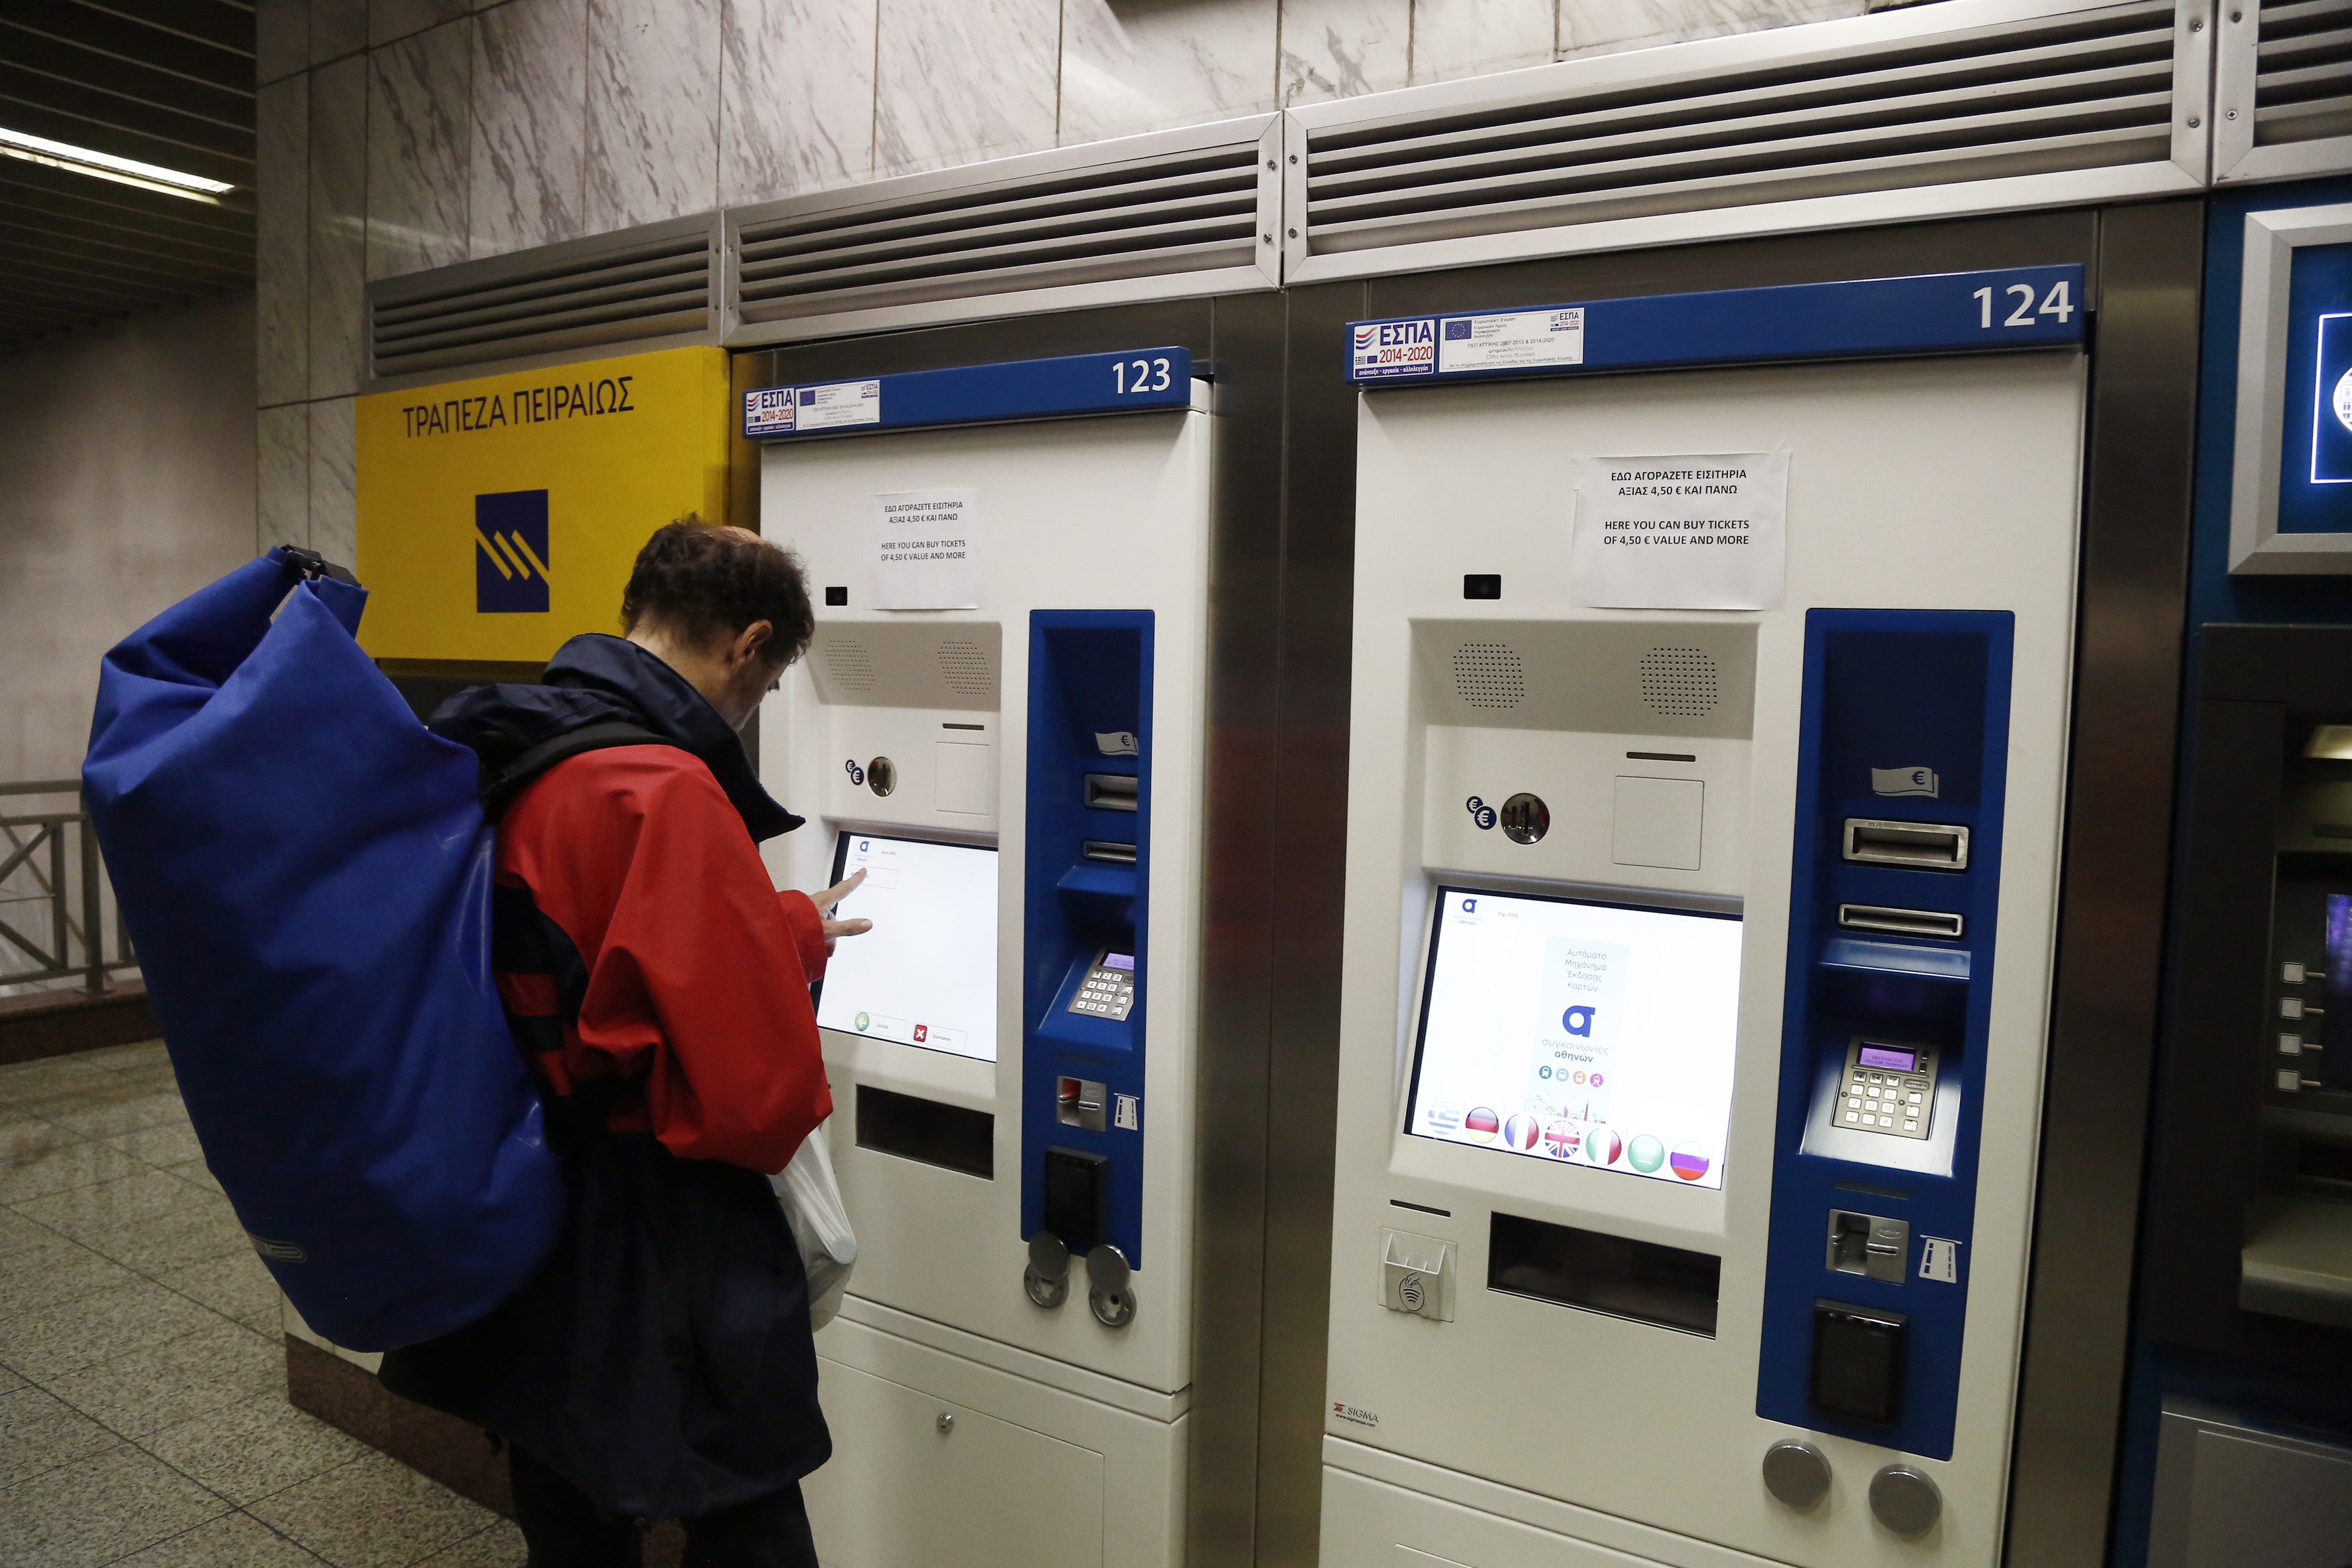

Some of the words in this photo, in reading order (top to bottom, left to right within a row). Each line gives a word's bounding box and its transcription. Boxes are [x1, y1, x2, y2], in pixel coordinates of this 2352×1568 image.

[1974, 281, 2074, 328] 124
[1380, 322, 1433, 346] ΕΣΠΑ
[1379, 346, 1433, 363] 2014-2020
[1113, 358, 1170, 394] 123
[762, 390, 793, 408] ΕΣΠΑ
[402, 394, 507, 438] ΤΡΑΠΕΖΑ
[513, 375, 634, 425] ΠΕΙΡΑΙΩΣ
[762, 408, 793, 422] 2014-2020
[1611, 472, 1632, 481] ΕΔΩ
[1634, 471, 1693, 481] ΑΓΟΡΑΖΕΤΕ
[1696, 470, 1747, 479] ΕΙΣΙΤΗΡΙΑ
[1618, 487, 1648, 495] ΑΞΙΑΣ
[1650, 486, 1673, 497] 4,50
[1676, 486, 1682, 495] €
[1685, 486, 1702, 495] ΚΑΙ
[1705, 485, 1737, 494] ΠΑΝΩ
[898, 503, 931, 511] ΑΓΟΡΑΖΕΤΕ
[1605, 521, 1630, 530] HERE
[1633, 521, 1656, 530] YOU
[1659, 520, 1680, 529] CAN
[1684, 520, 1705, 529] BUY
[1708, 520, 1749, 529] TICKETS
[1604, 536, 1617, 544] OF
[1620, 536, 1641, 546] 4,50
[1644, 536, 1650, 544] €
[1653, 536, 1687, 544] VALUE
[1689, 535, 1713, 544] AND
[1717, 535, 1749, 544] MORE
[890, 553, 903, 562] 4,50
[1567, 949, 1607, 960] Αυτόματο
[1565, 959, 1606, 971] Μηχάνημα
[1567, 970, 1602, 983] Έκδοσης
[1567, 981, 1598, 992] Καρτών
[1542, 1039, 1609, 1056] συγκοινωνίες
[1555, 1050, 1593, 1062] αθηνών
[1348, 1407, 1378, 1423] SIGMA
